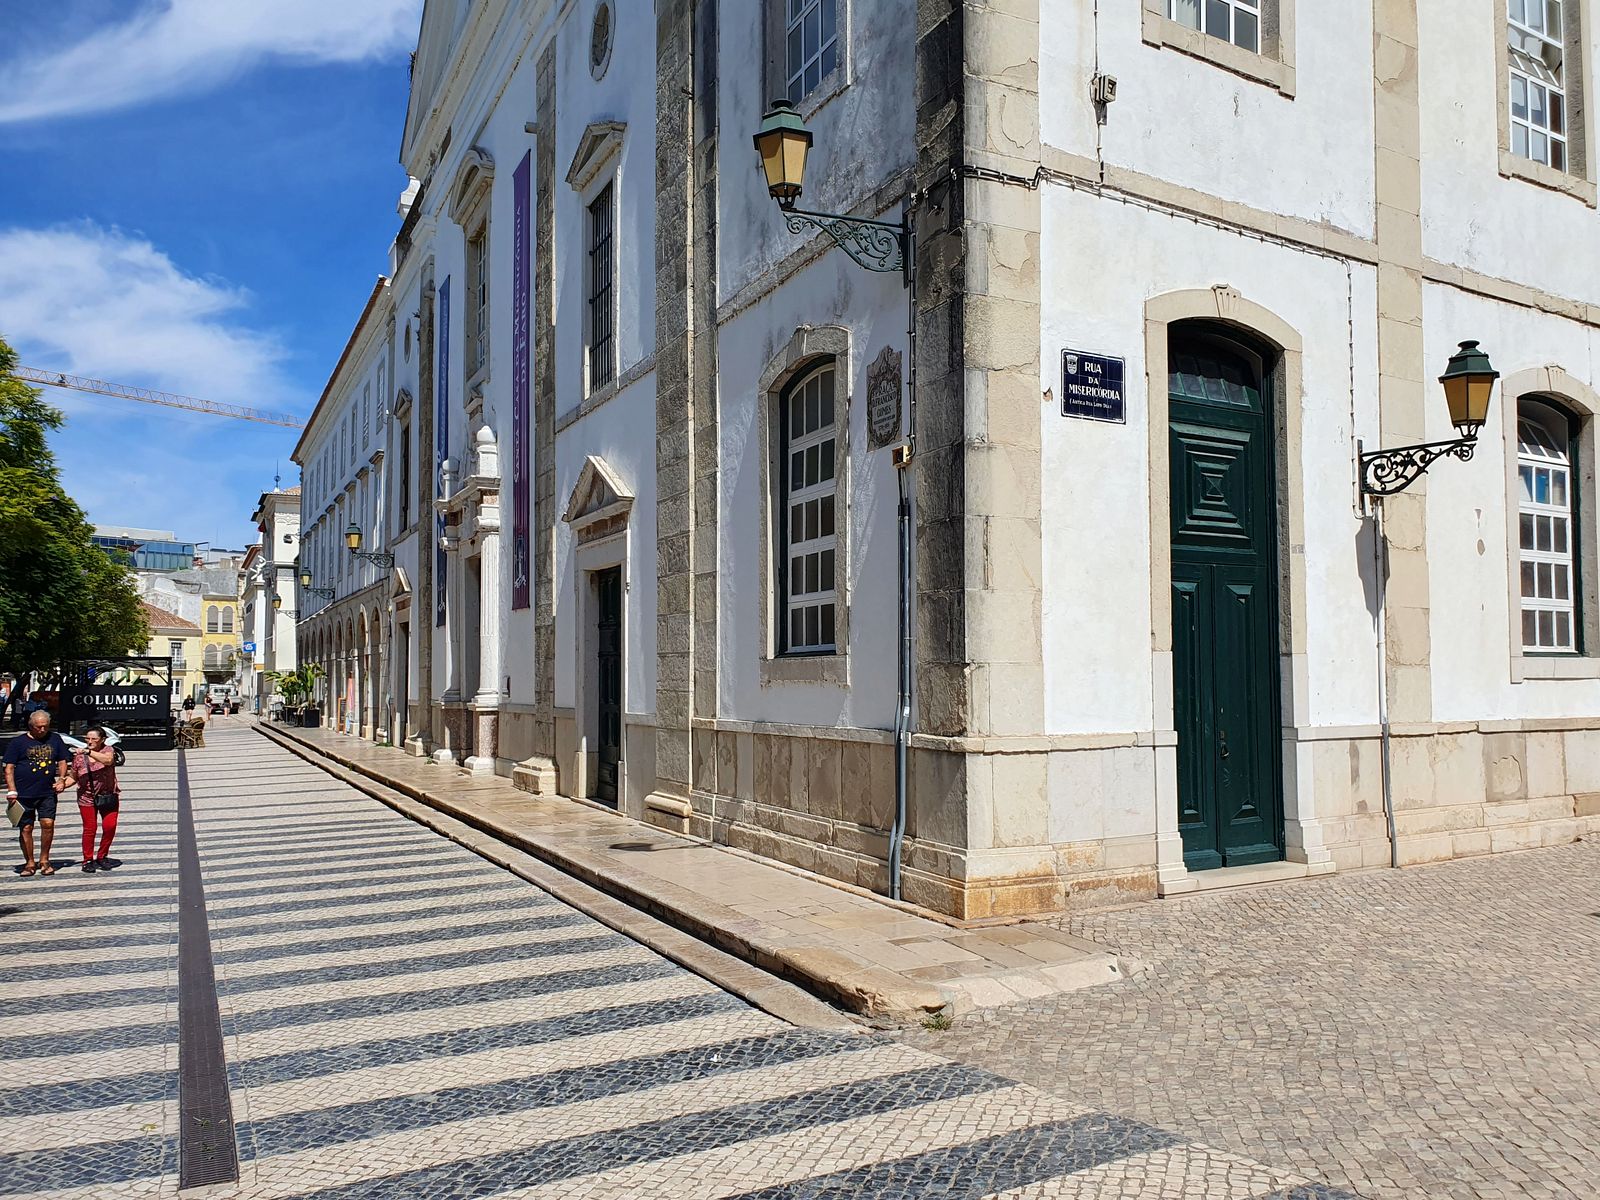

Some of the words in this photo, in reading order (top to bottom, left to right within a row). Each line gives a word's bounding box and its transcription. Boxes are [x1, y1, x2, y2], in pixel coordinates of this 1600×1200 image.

[1085, 362, 1102, 373] RUA
[1088, 376, 1099, 384] DA
[1068, 383, 1120, 400] MISERICÓRDIA
[72, 694, 158, 705] COLUMBUS
